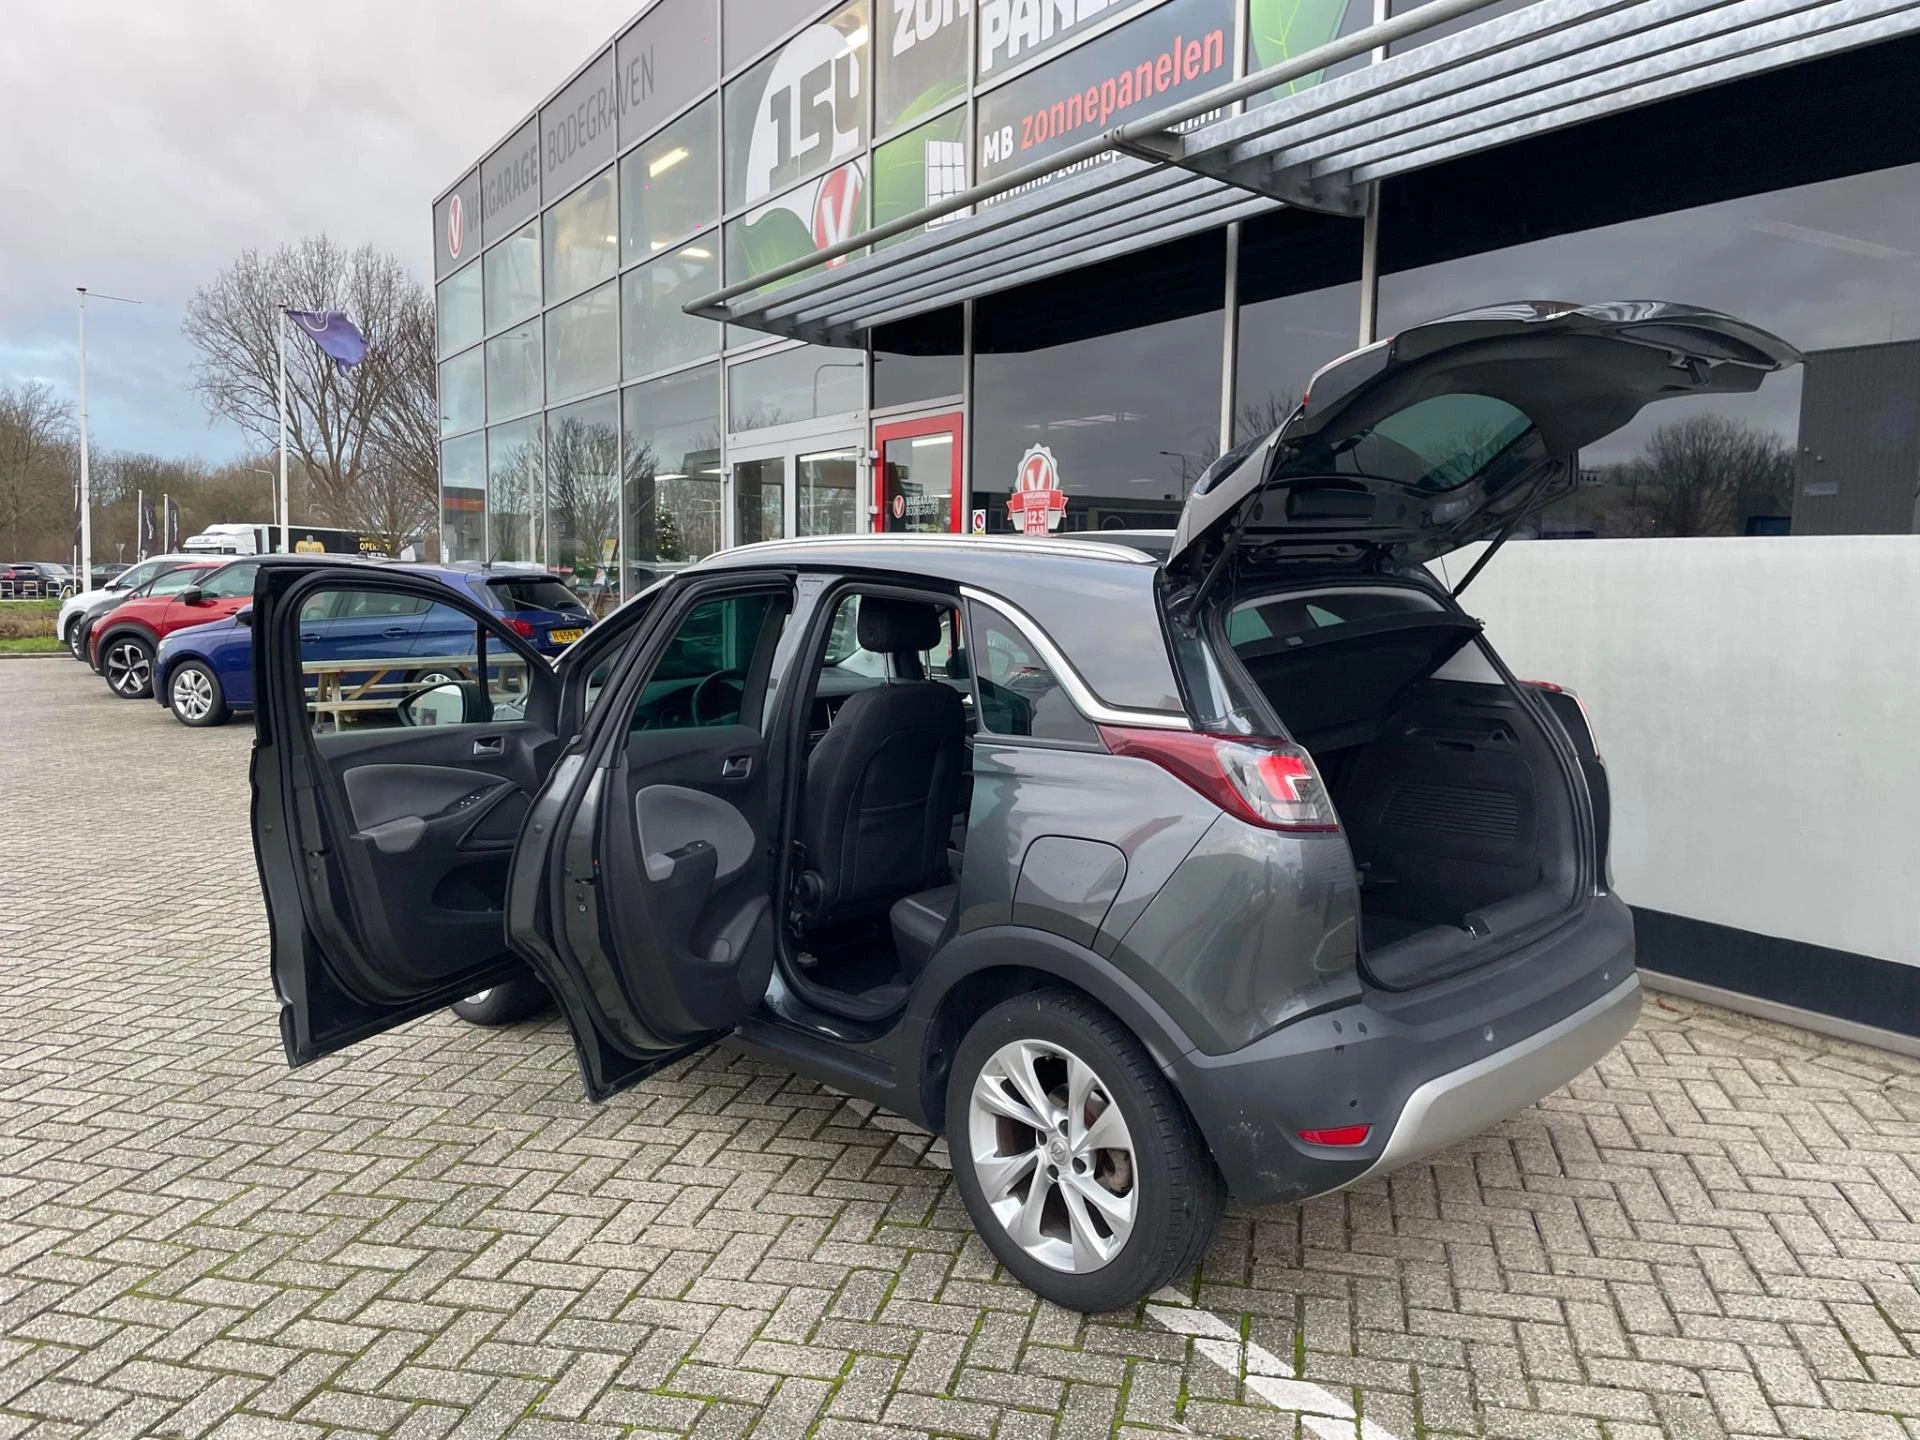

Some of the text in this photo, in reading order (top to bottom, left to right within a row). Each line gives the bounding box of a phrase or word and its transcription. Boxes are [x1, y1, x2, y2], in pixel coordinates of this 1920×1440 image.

[548, 46, 655, 173] BODEGRAVEN
[983, 28, 1225, 168] MB zonnepanelen
[1027, 510, 1045, 524] 125
